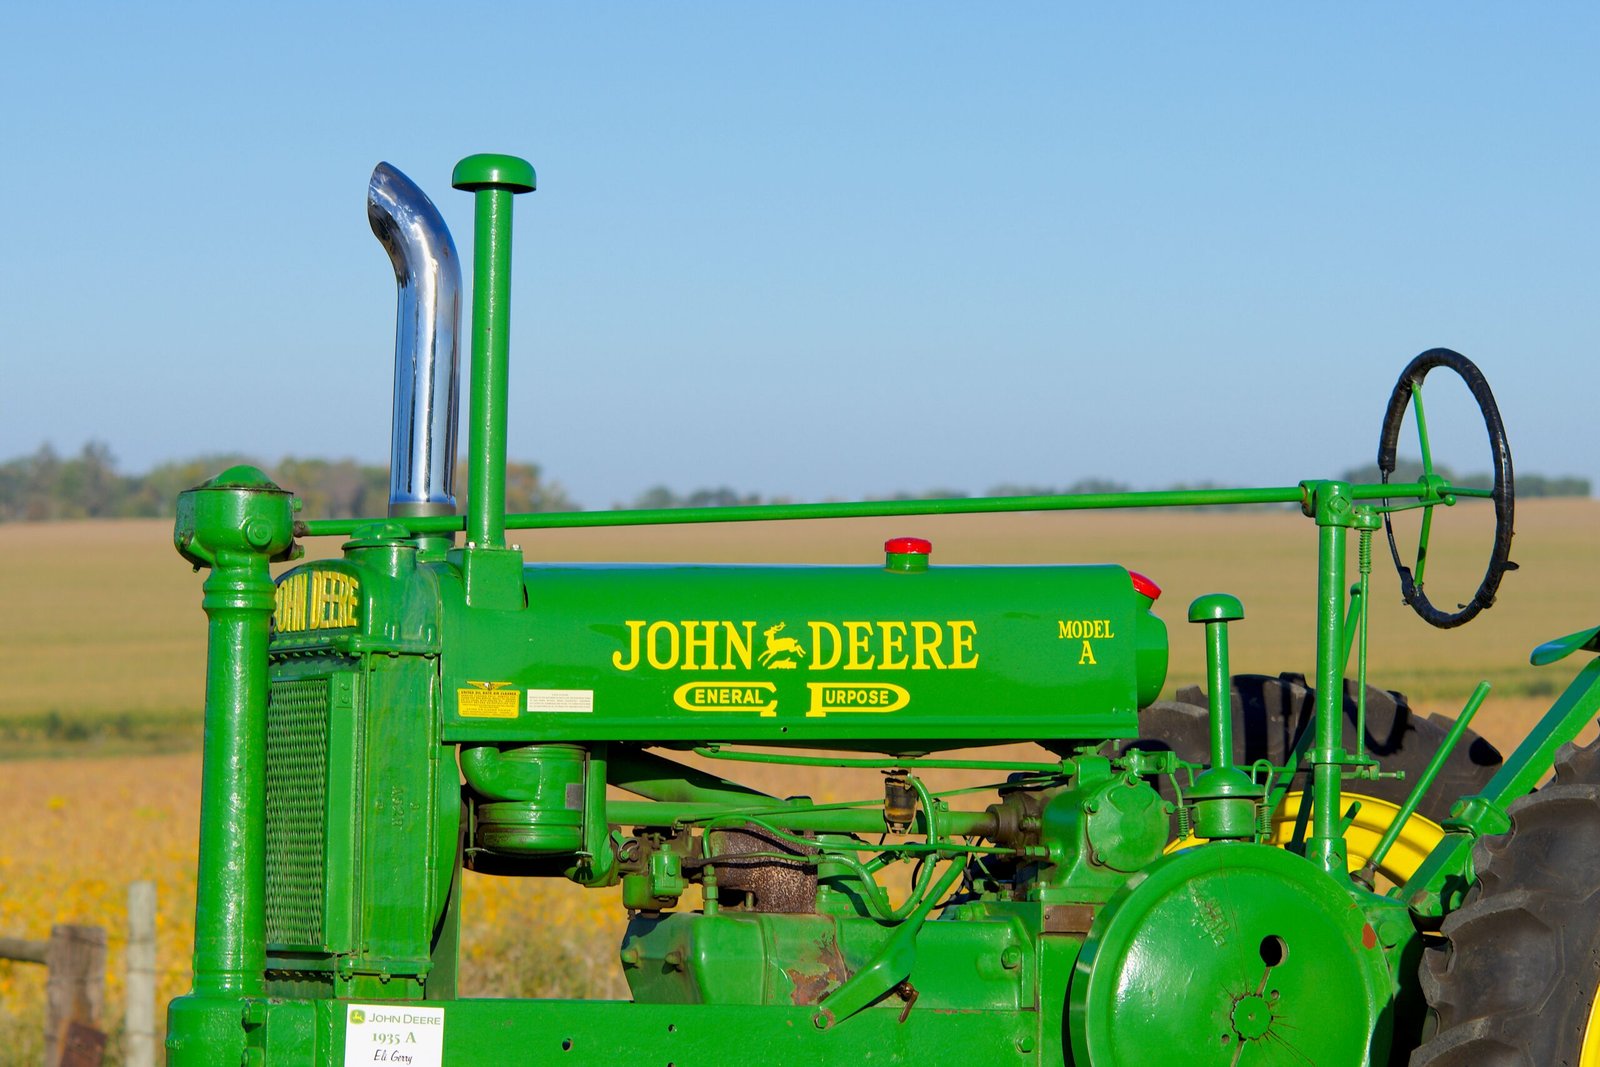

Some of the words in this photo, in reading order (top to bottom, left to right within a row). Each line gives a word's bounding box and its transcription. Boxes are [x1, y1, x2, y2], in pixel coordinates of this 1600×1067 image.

[310, 571, 359, 629] DEERE
[1058, 620, 1115, 639] MODEL
[612, 620, 756, 671] JOHN
[808, 620, 979, 670] DEERE
[1078, 640, 1097, 665] A
[368, 1012, 401, 1024] JOHN
[403, 1013, 441, 1025] DEERE
[372, 1032, 401, 1045] 1935
[405, 1031, 417, 1044] A
[373, 1048, 387, 1062] Eli
